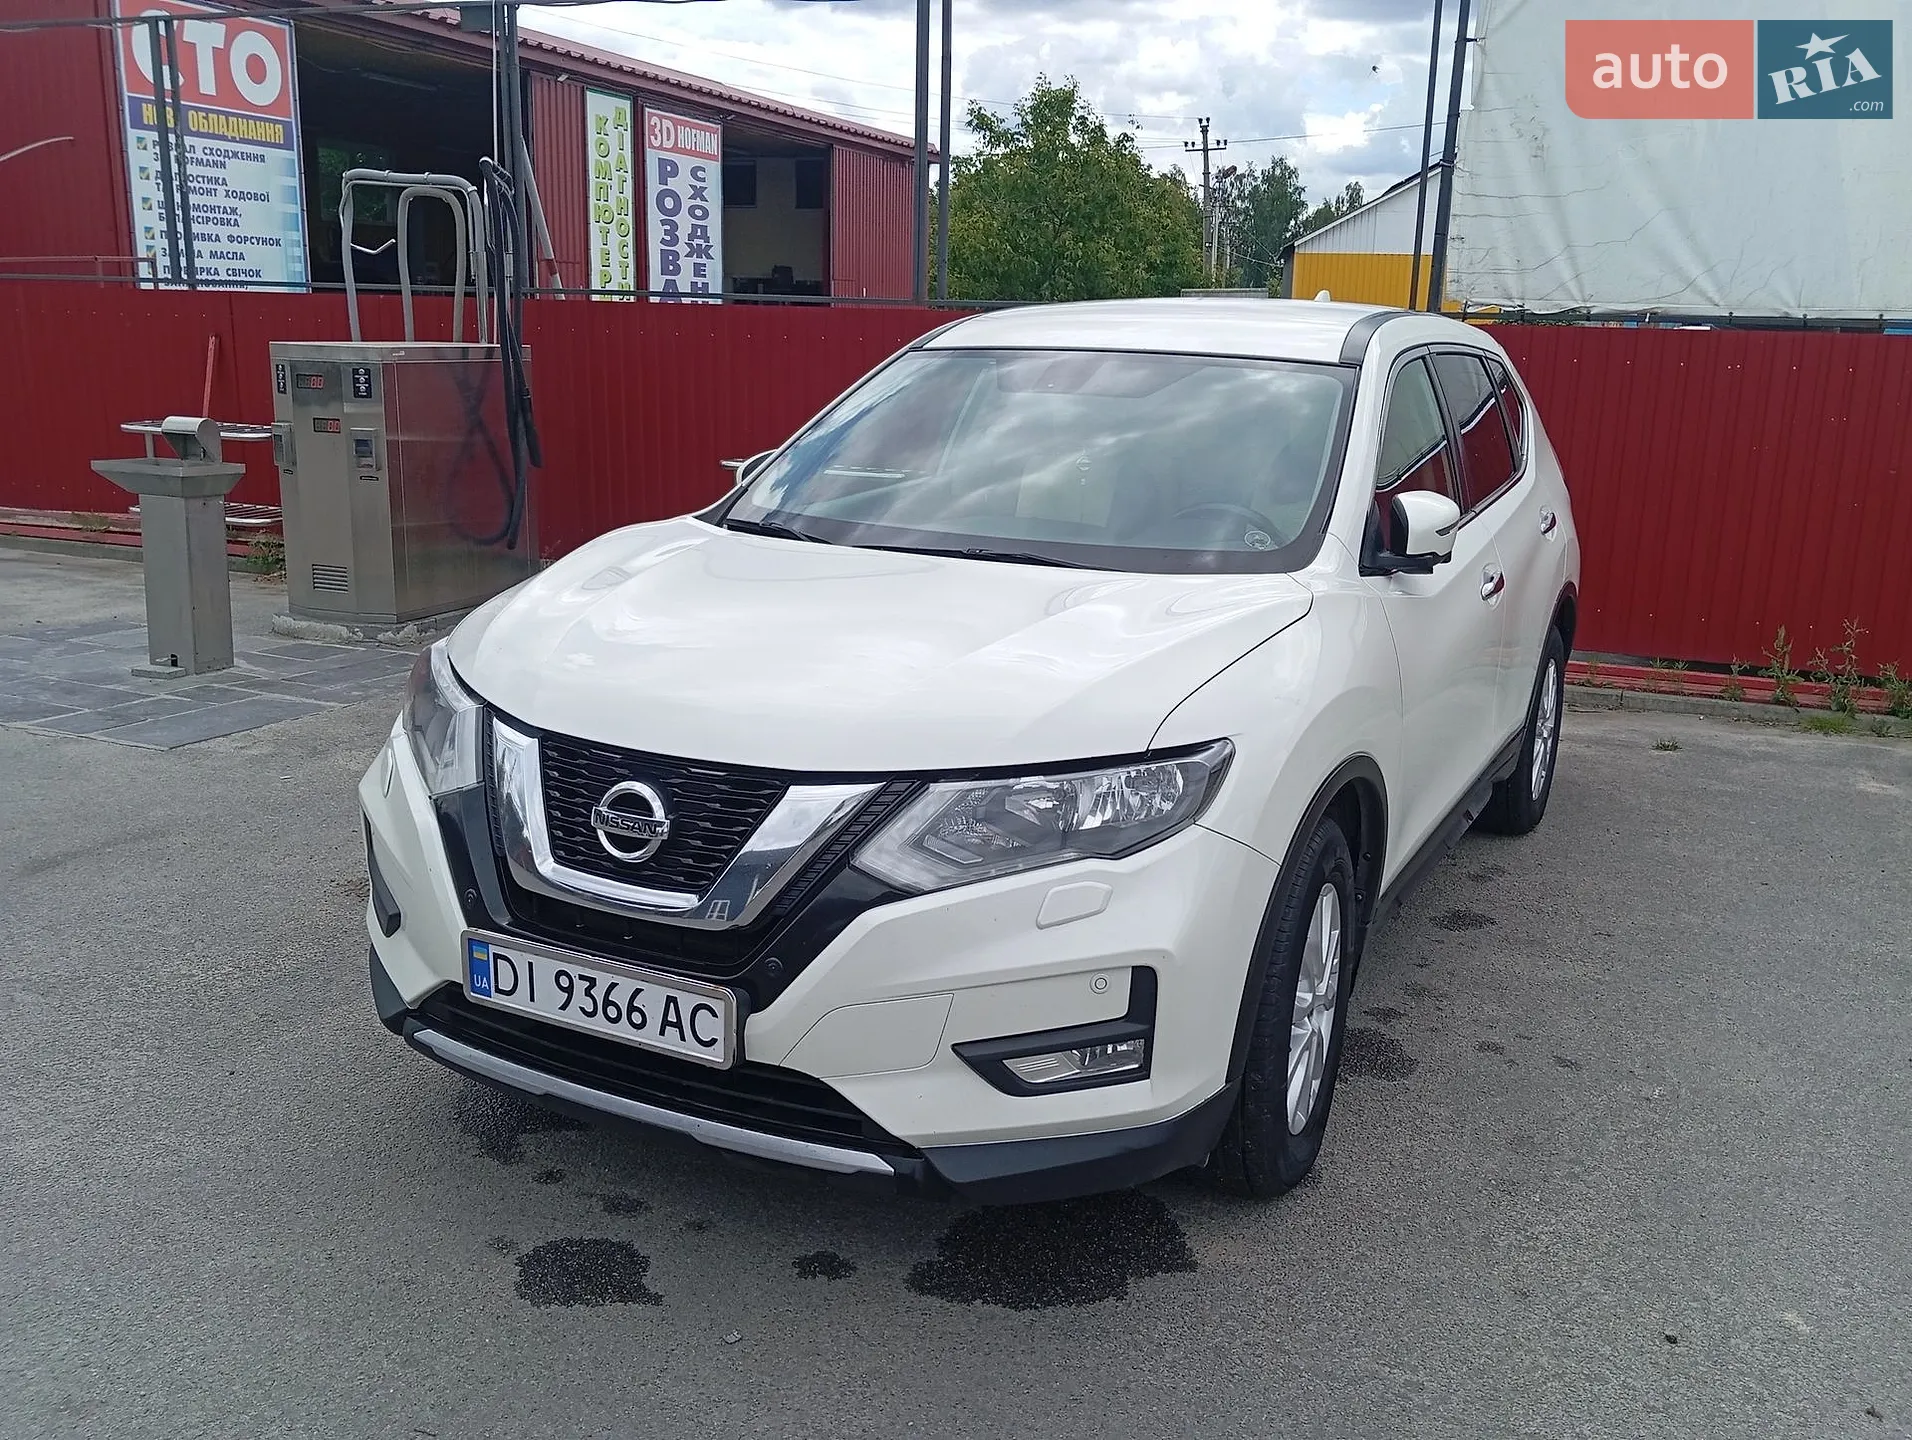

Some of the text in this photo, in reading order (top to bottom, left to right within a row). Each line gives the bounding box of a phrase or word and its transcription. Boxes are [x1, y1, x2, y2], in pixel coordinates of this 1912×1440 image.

[132, 9, 282, 107] СТО
[188, 110, 284, 144] ОБЛАДНАННЯ
[650, 116, 718, 156] 3D HOFMAN
[202, 146, 266, 164] СХОДЖЕННЯ
[224, 188, 270, 204] ХОДОВОЇ
[227, 233, 282, 247] ФОРСУНОК
[684, 165, 715, 304] СХОДЖЕН
[209, 250, 246, 261] МАСЛА
[226, 267, 262, 279] СВІЧОК
[595, 809, 658, 838] NISSAN
[474, 974, 489, 990] UA
[492, 952, 719, 1048] DI 9366 AC
